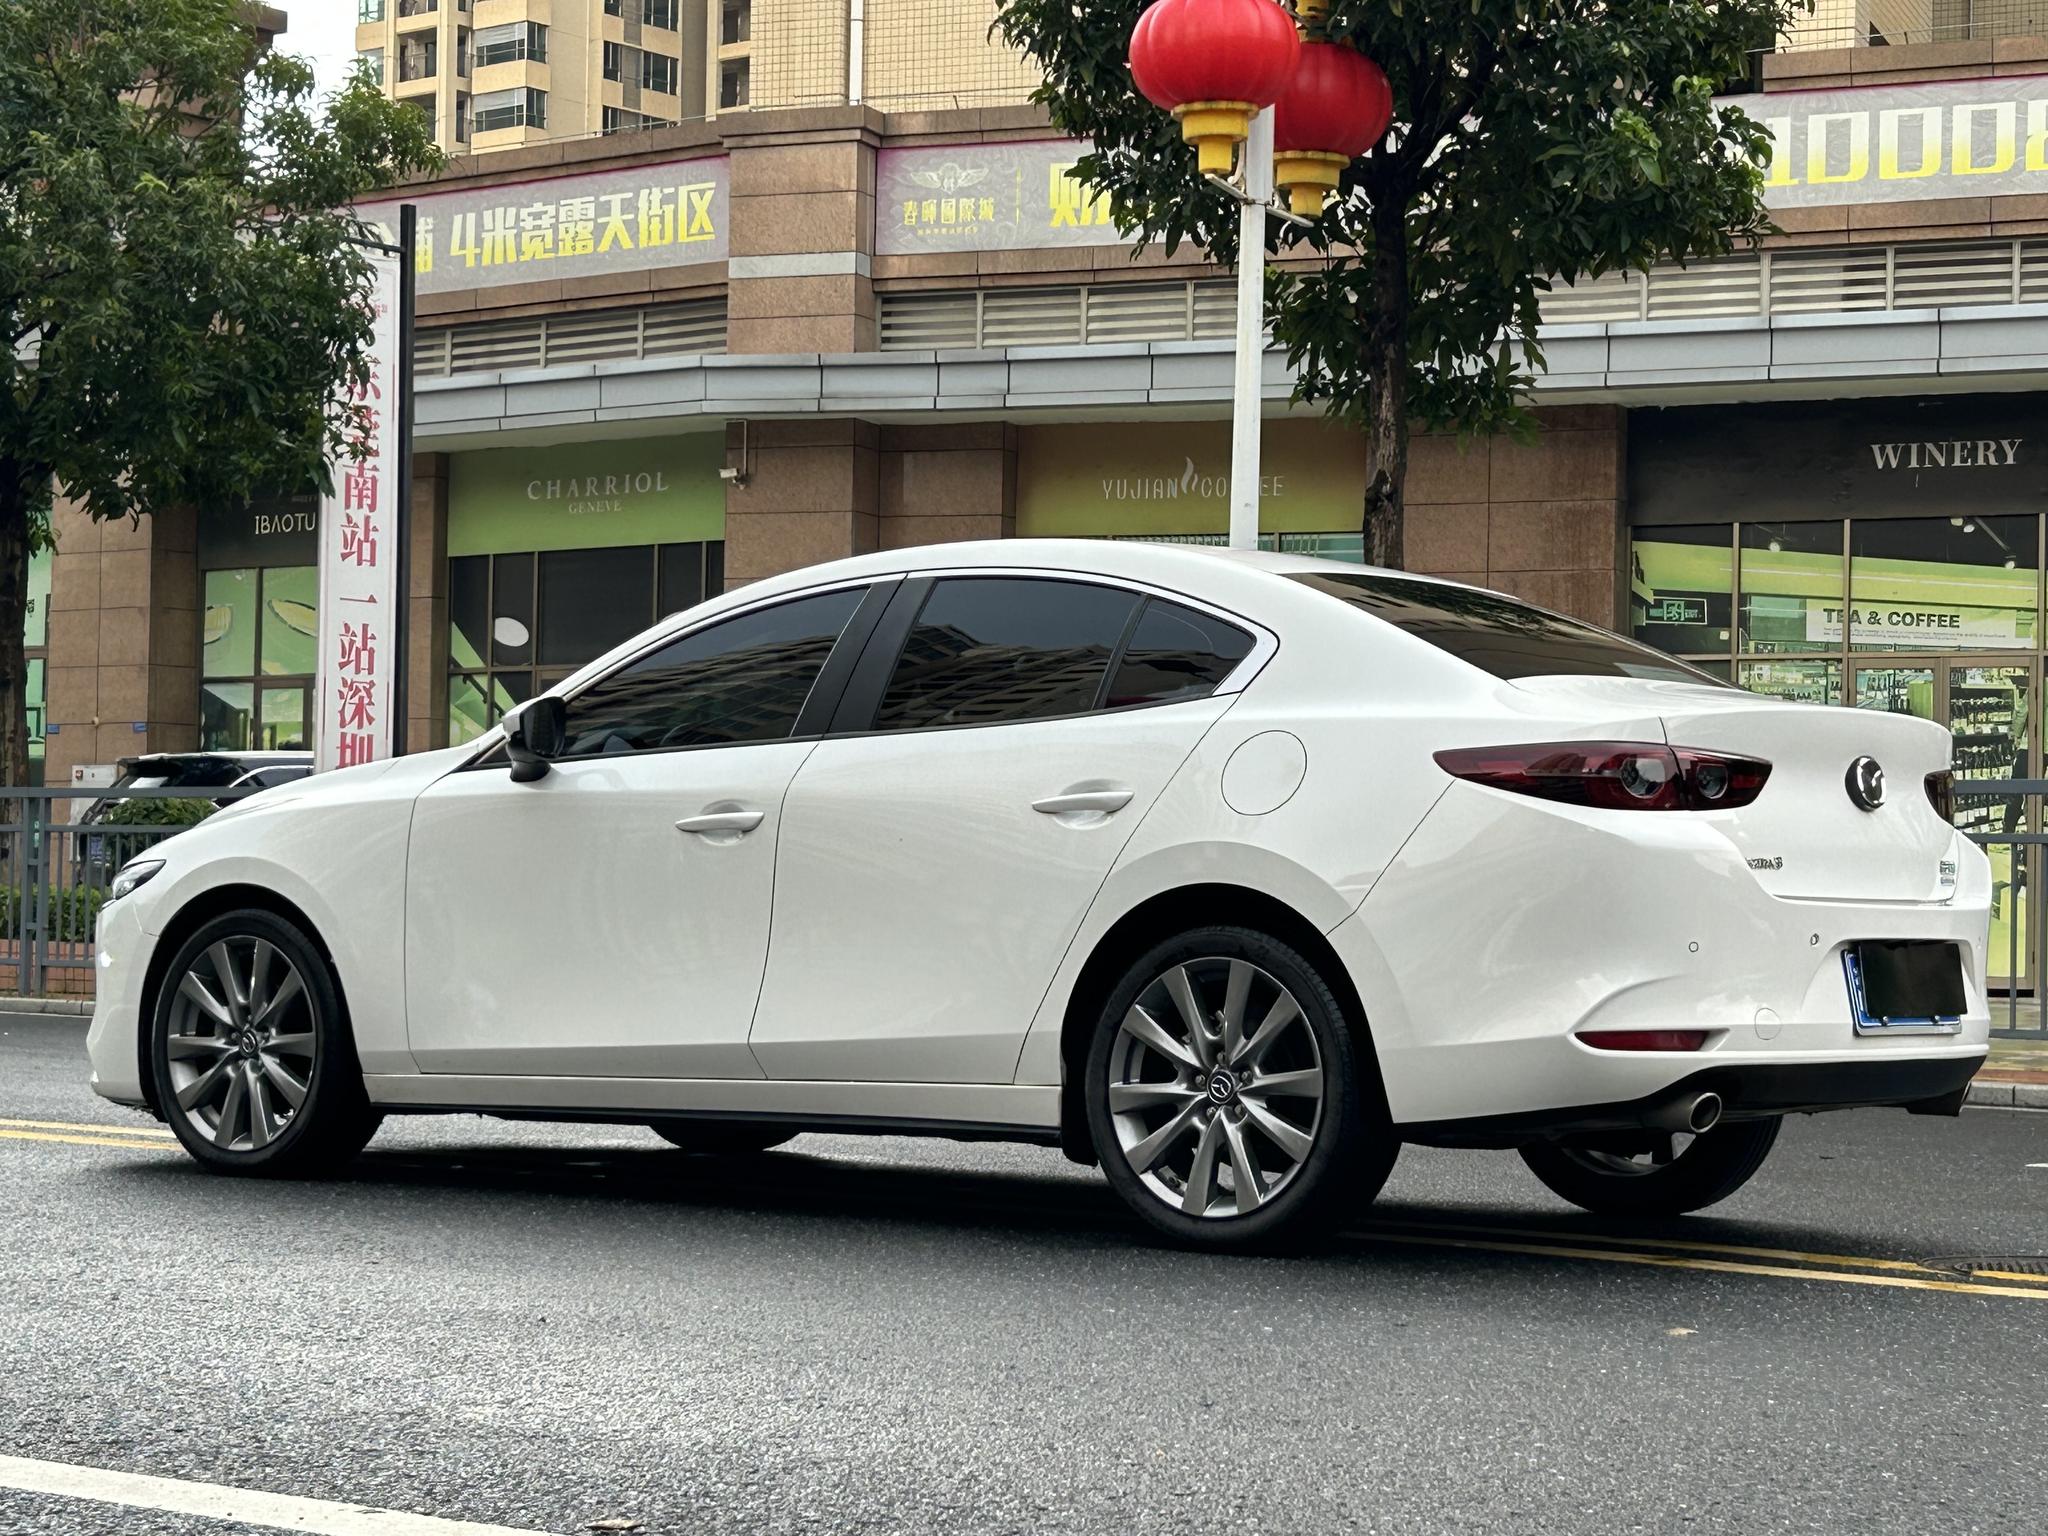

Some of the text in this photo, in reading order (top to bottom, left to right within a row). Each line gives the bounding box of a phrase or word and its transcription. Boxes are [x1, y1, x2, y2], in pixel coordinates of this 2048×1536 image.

[450, 181, 717, 268] 4米宽露天街区
[1870, 438, 2023, 470] WINERY
[527, 471, 669, 500] CHARRIOL
[1102, 475, 1286, 500] YUJIAN COEE
[568, 499, 622, 514] GENEVE
[1823, 608, 1960, 628] TEA & COFFEE
[336, 594, 378, 770] 一站深圳
